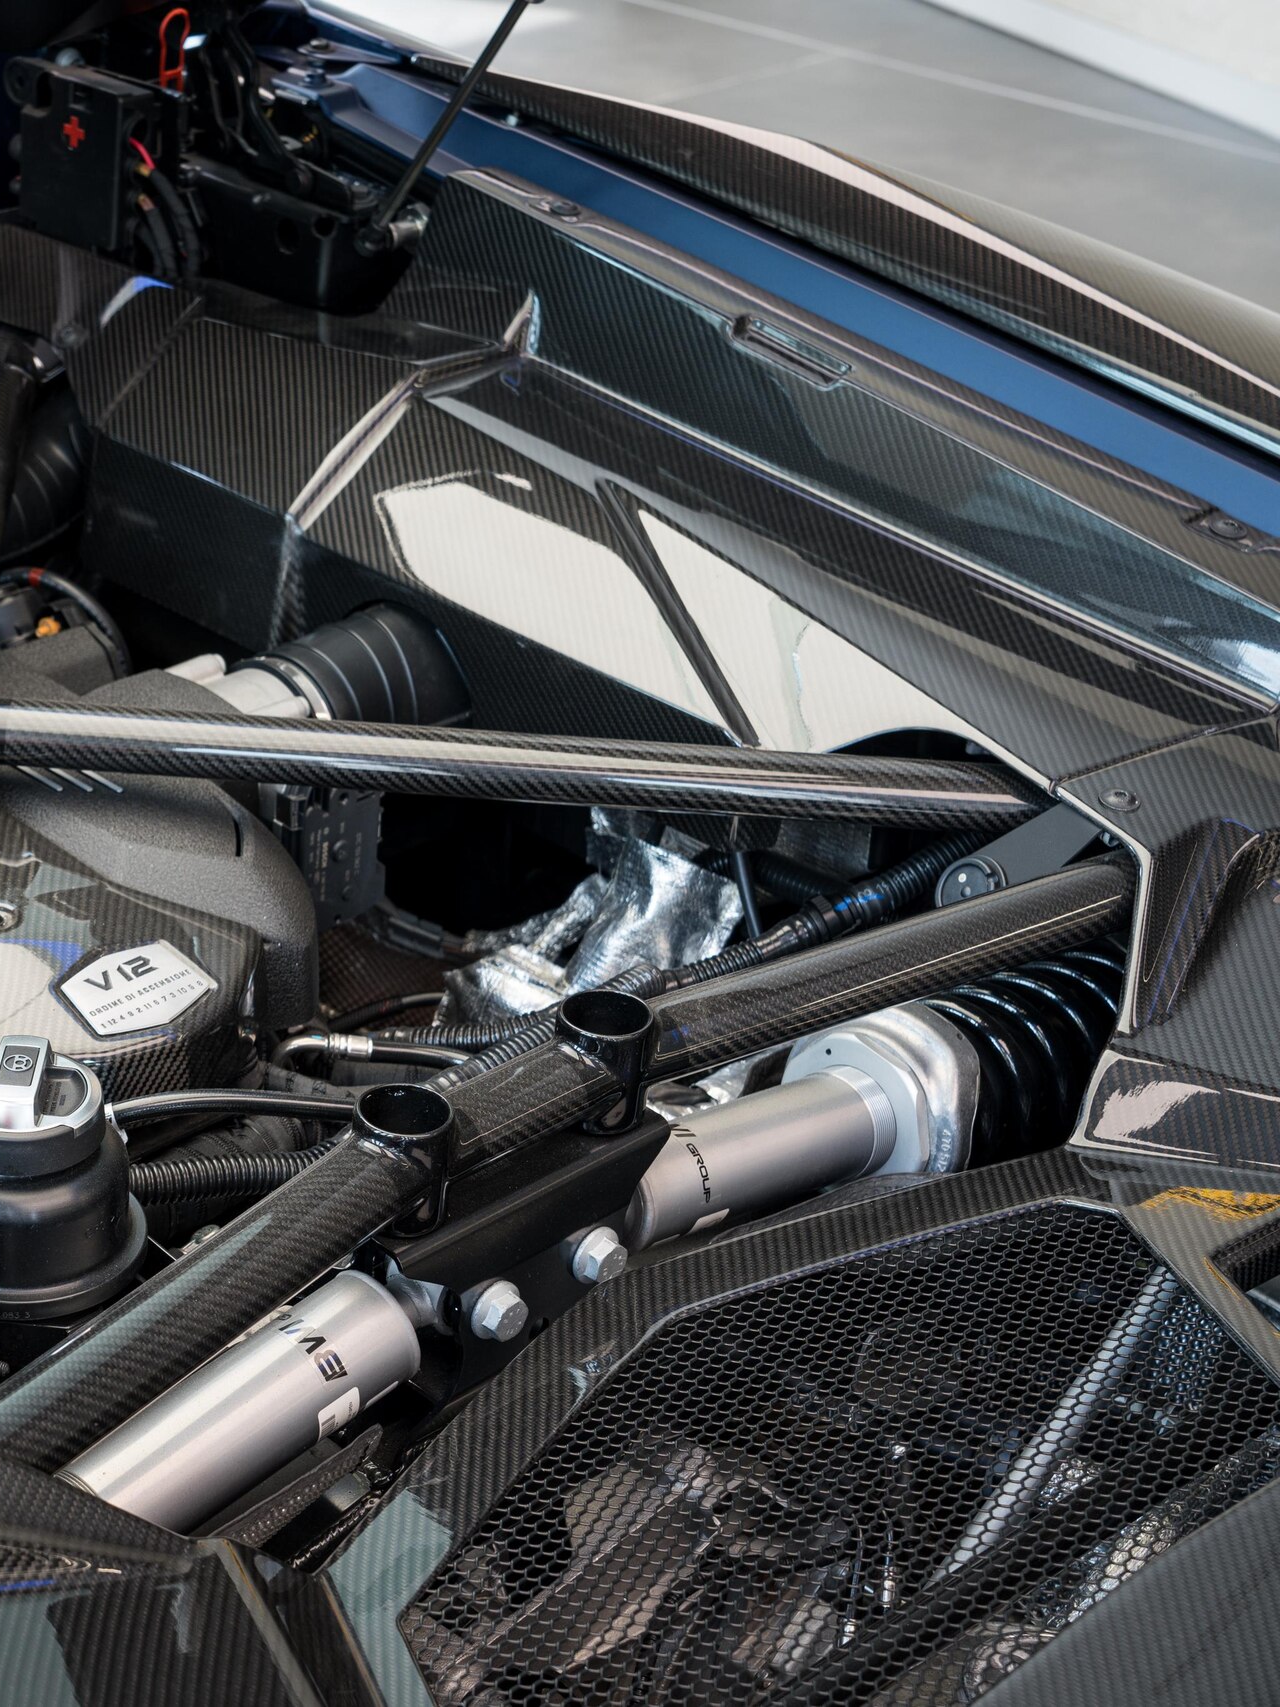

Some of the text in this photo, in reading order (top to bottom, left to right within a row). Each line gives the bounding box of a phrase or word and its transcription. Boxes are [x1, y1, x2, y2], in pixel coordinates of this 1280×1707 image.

[83, 955, 159, 991] V12
[89, 969, 192, 1017] ORDINE DI ACCENSIONE
[101, 1021, 107, 1029] 1
[107, 1018, 118, 1027] 12
[177, 987, 187, 995] 10
[686, 1142, 711, 1204] GROUP
